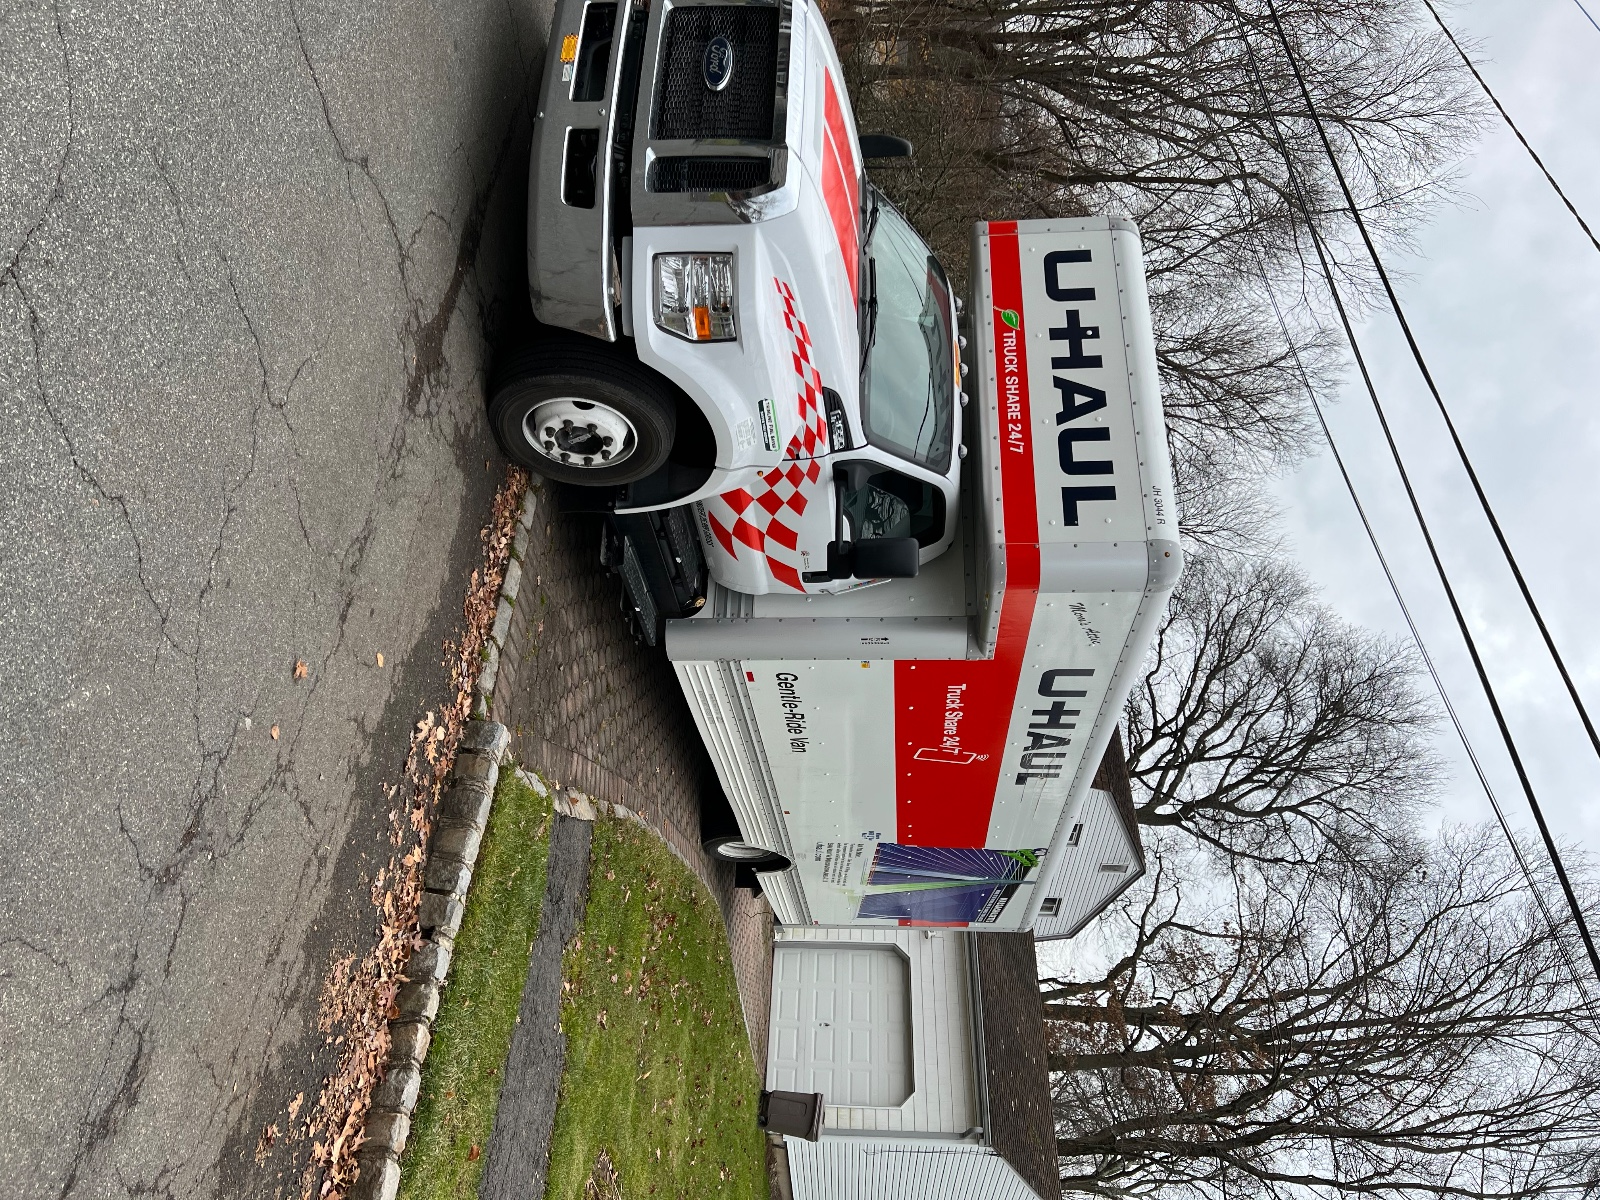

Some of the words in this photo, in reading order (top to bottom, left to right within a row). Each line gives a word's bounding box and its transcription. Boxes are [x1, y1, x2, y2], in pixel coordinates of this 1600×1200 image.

[709, 45, 728, 74] Ford
[1003, 330, 1018, 372] TRUCK
[1006, 376, 1021, 420] SHARE
[1044, 250, 1116, 526] U-HAUL
[1008, 423, 1024, 453] 24/7
[1152, 486, 1162, 496] JH
[1154, 498, 1164, 516] 3044
[1069, 602, 1091, 626] Mom's
[775, 672, 808, 734] Gentle-Ride
[946, 684, 966, 709] Truck
[944, 711, 964, 735] Share
[1015, 668, 1096, 785] U-HAUL
[789, 737, 809, 753] Van
[939, 736, 962, 754] 24/7
